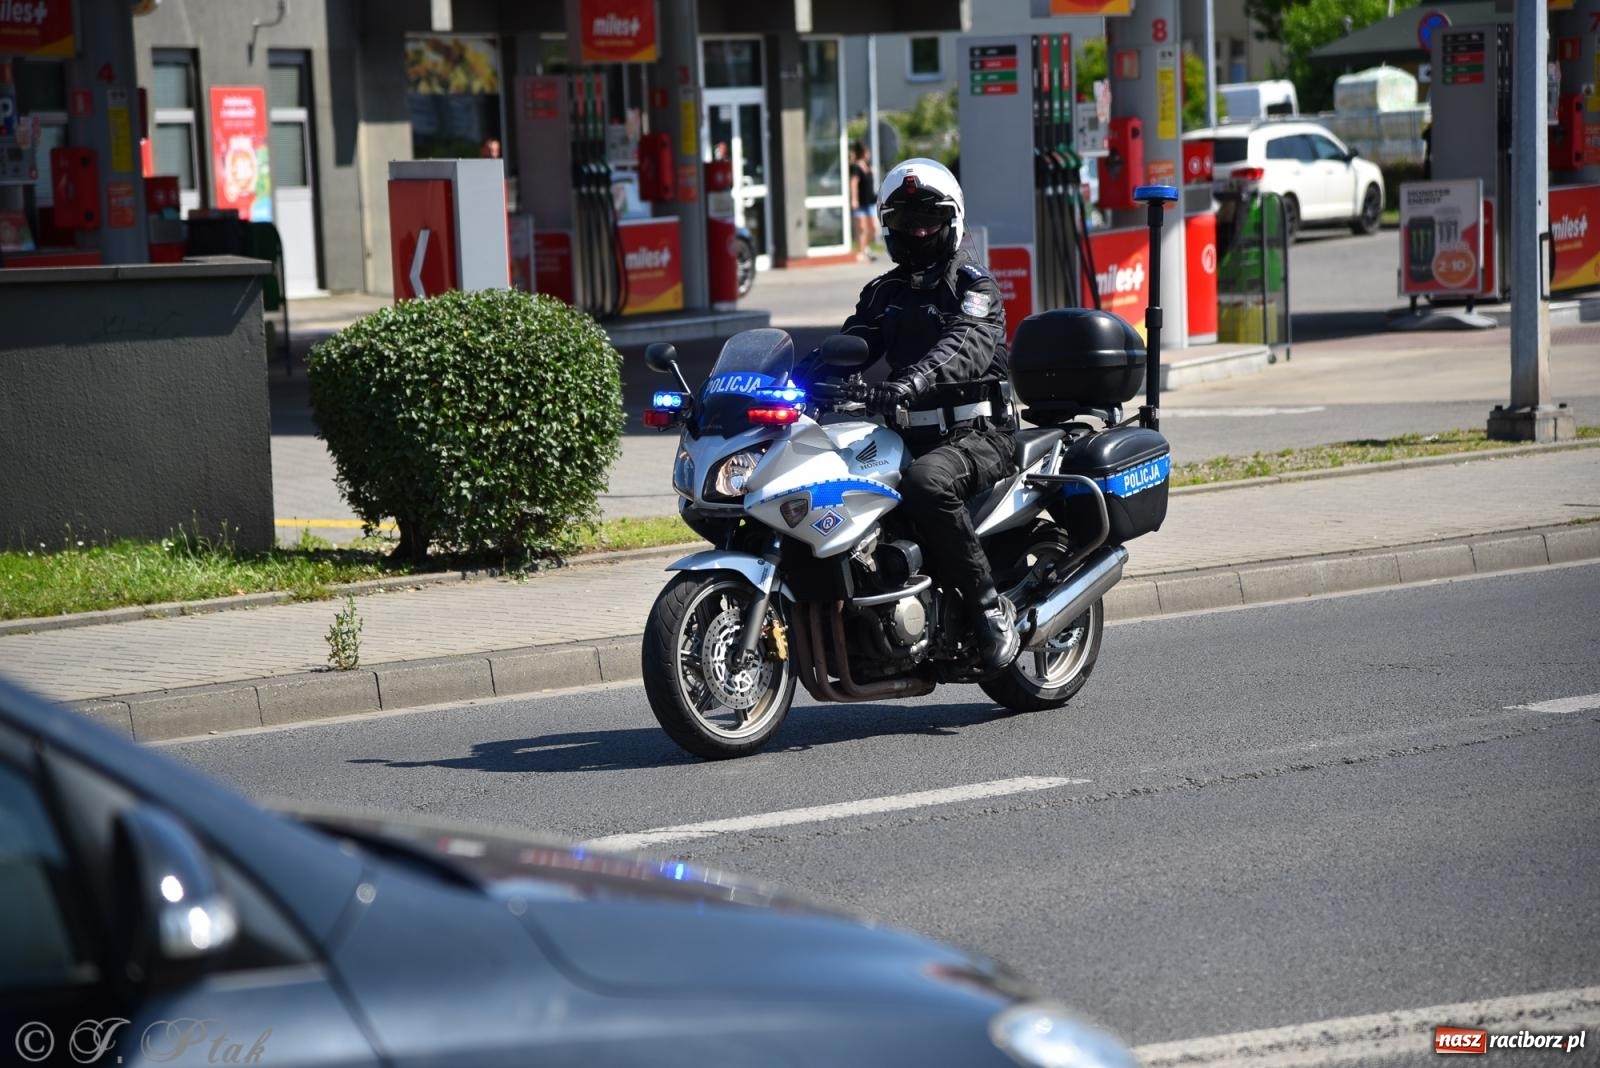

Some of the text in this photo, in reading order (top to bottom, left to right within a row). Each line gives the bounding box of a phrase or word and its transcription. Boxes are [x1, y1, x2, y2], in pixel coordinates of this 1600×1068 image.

[0, 0, 48, 24] iles+
[1152, 19, 1167, 43] 8
[96, 63, 113, 83] 4
[1551, 213, 1588, 241] miles+
[1095, 263, 1145, 296] miles+
[860, 459, 889, 470] HONDA
[1123, 464, 1161, 490] POLICJA
